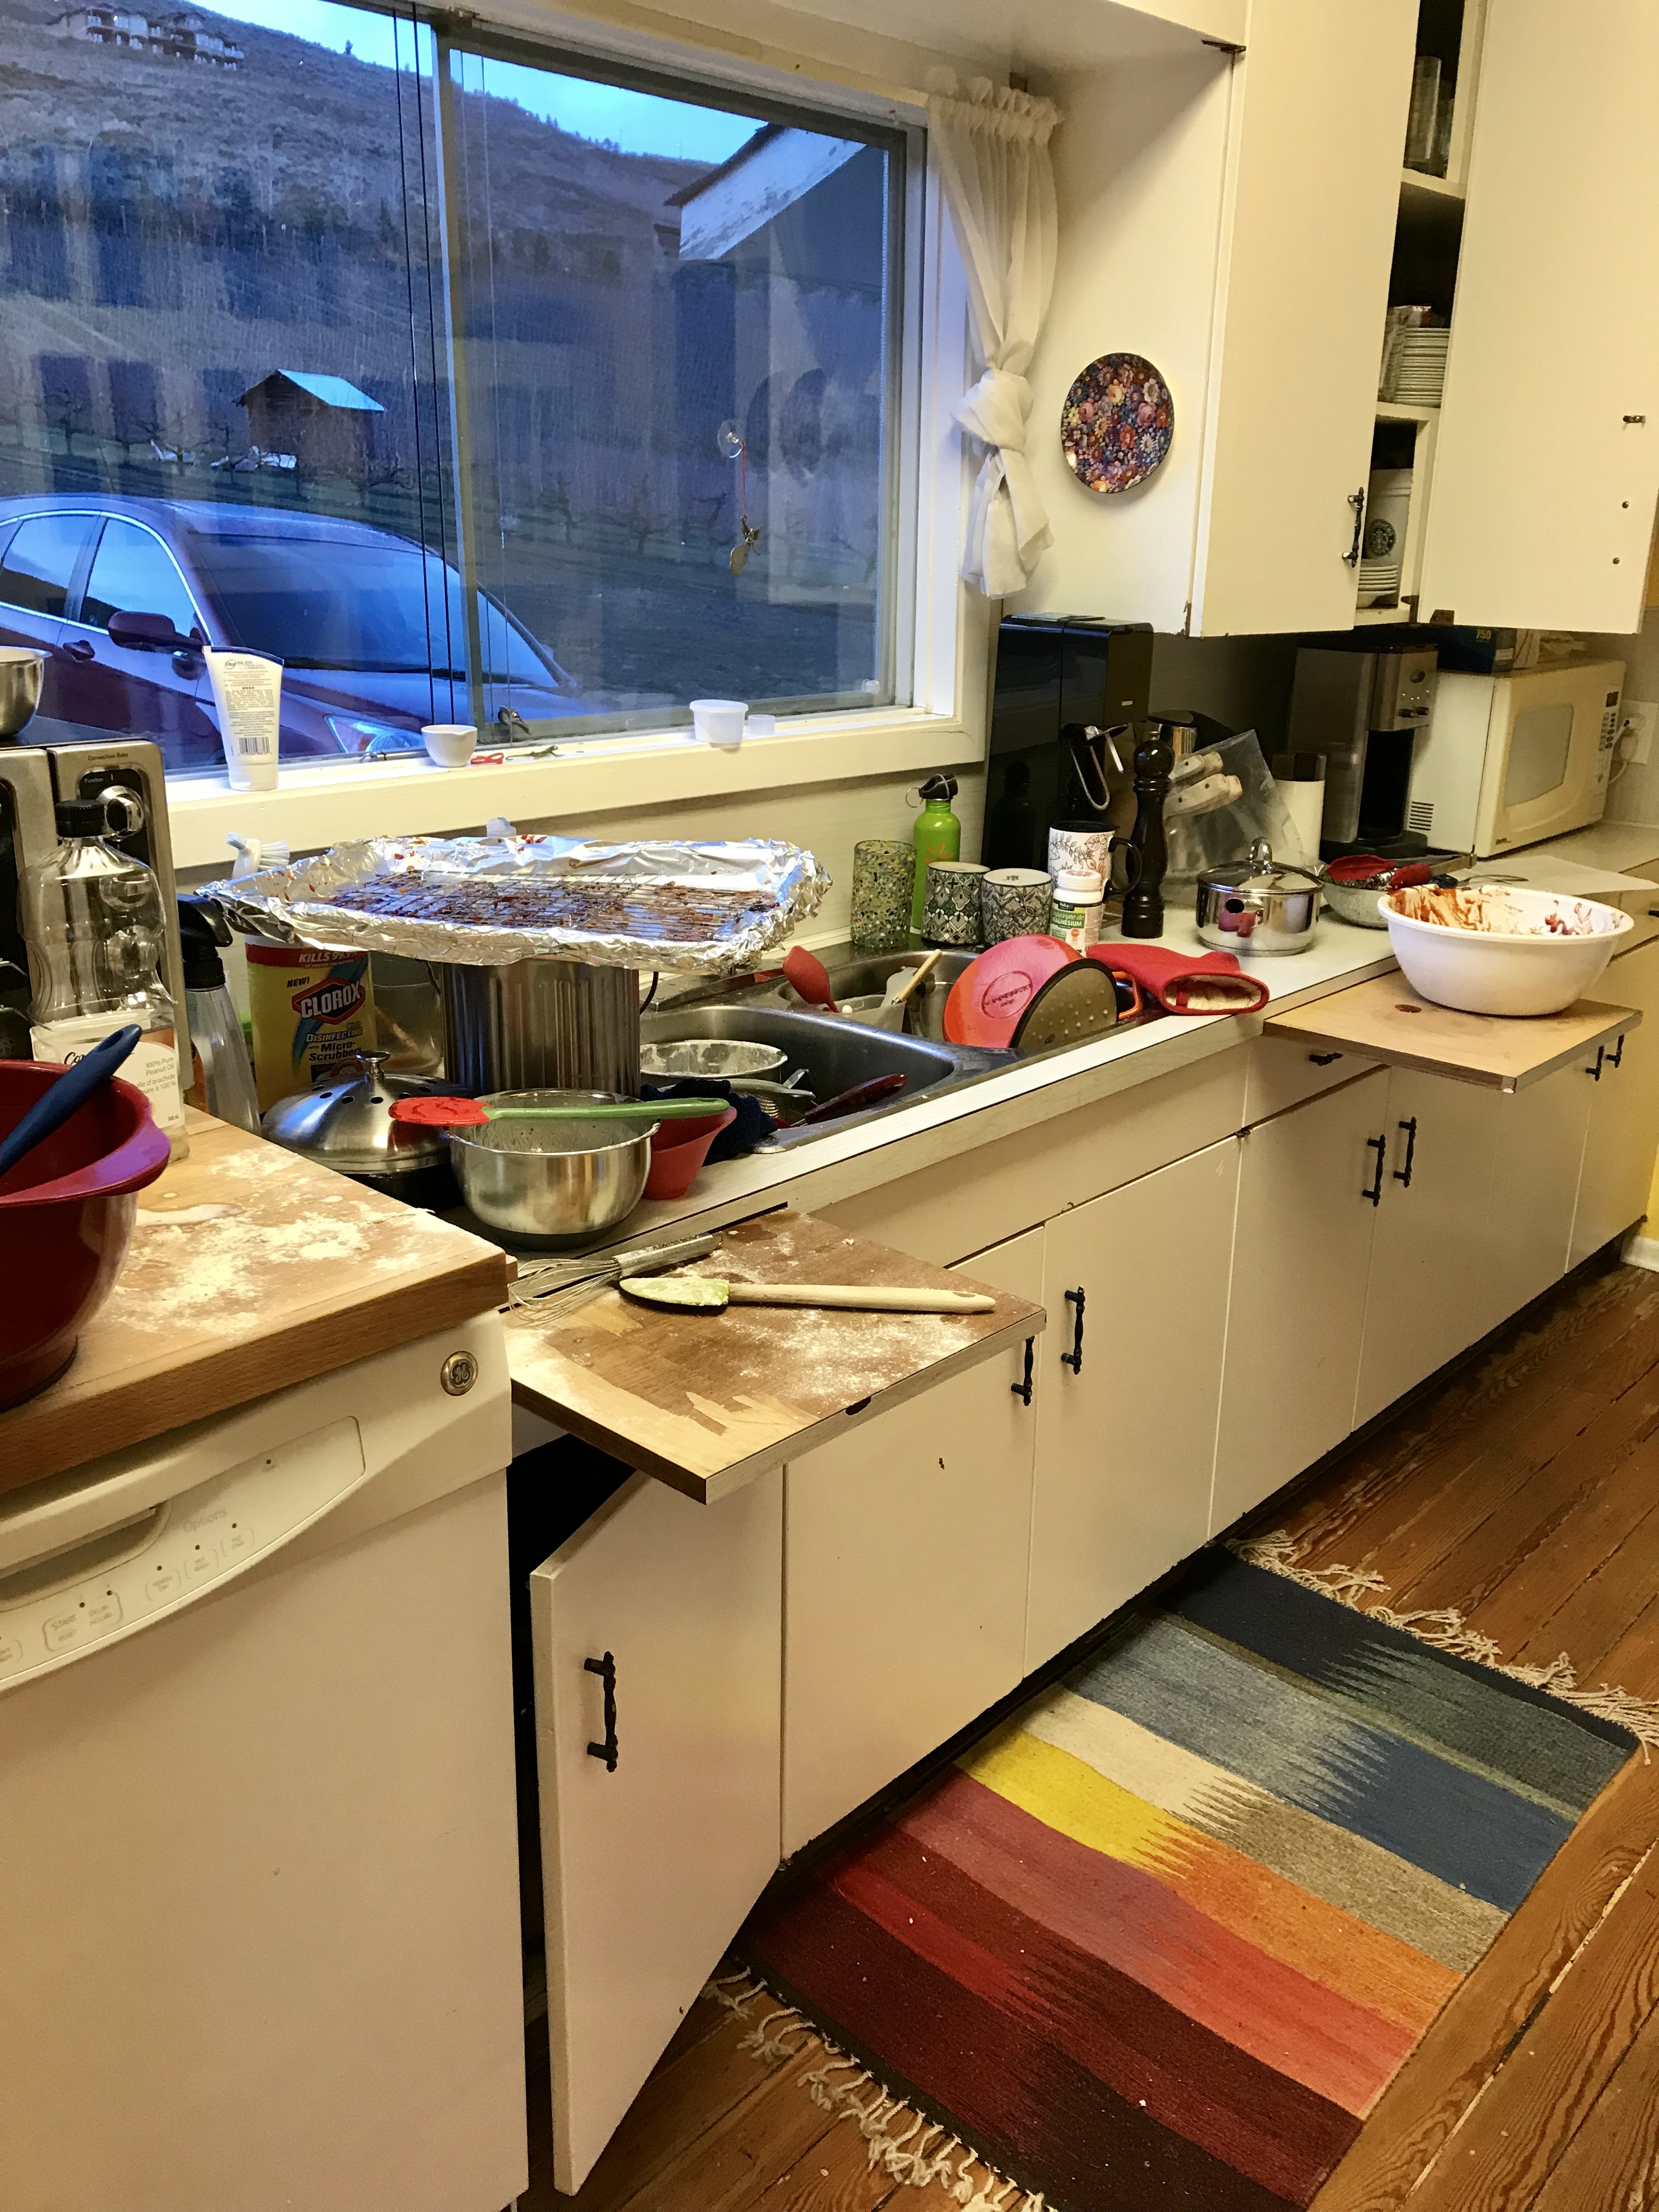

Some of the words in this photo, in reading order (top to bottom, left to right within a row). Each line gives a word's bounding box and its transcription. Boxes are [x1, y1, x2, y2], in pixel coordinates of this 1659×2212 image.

[298, 952, 331, 963] KILLS
[287, 977, 311, 988] NEW!
[301, 981, 361, 1019] CLOROX
[306, 1026, 363, 1043] DISINFECTING
[320, 1041, 356, 1052] Micro-
[308, 1047, 362, 1062] Scrubbers
[146, 1066, 166, 1076] Peanut
[161, 1082, 171, 1090] 100
[183, 1508, 228, 1532] Options
[52, 1614, 76, 1631] START
